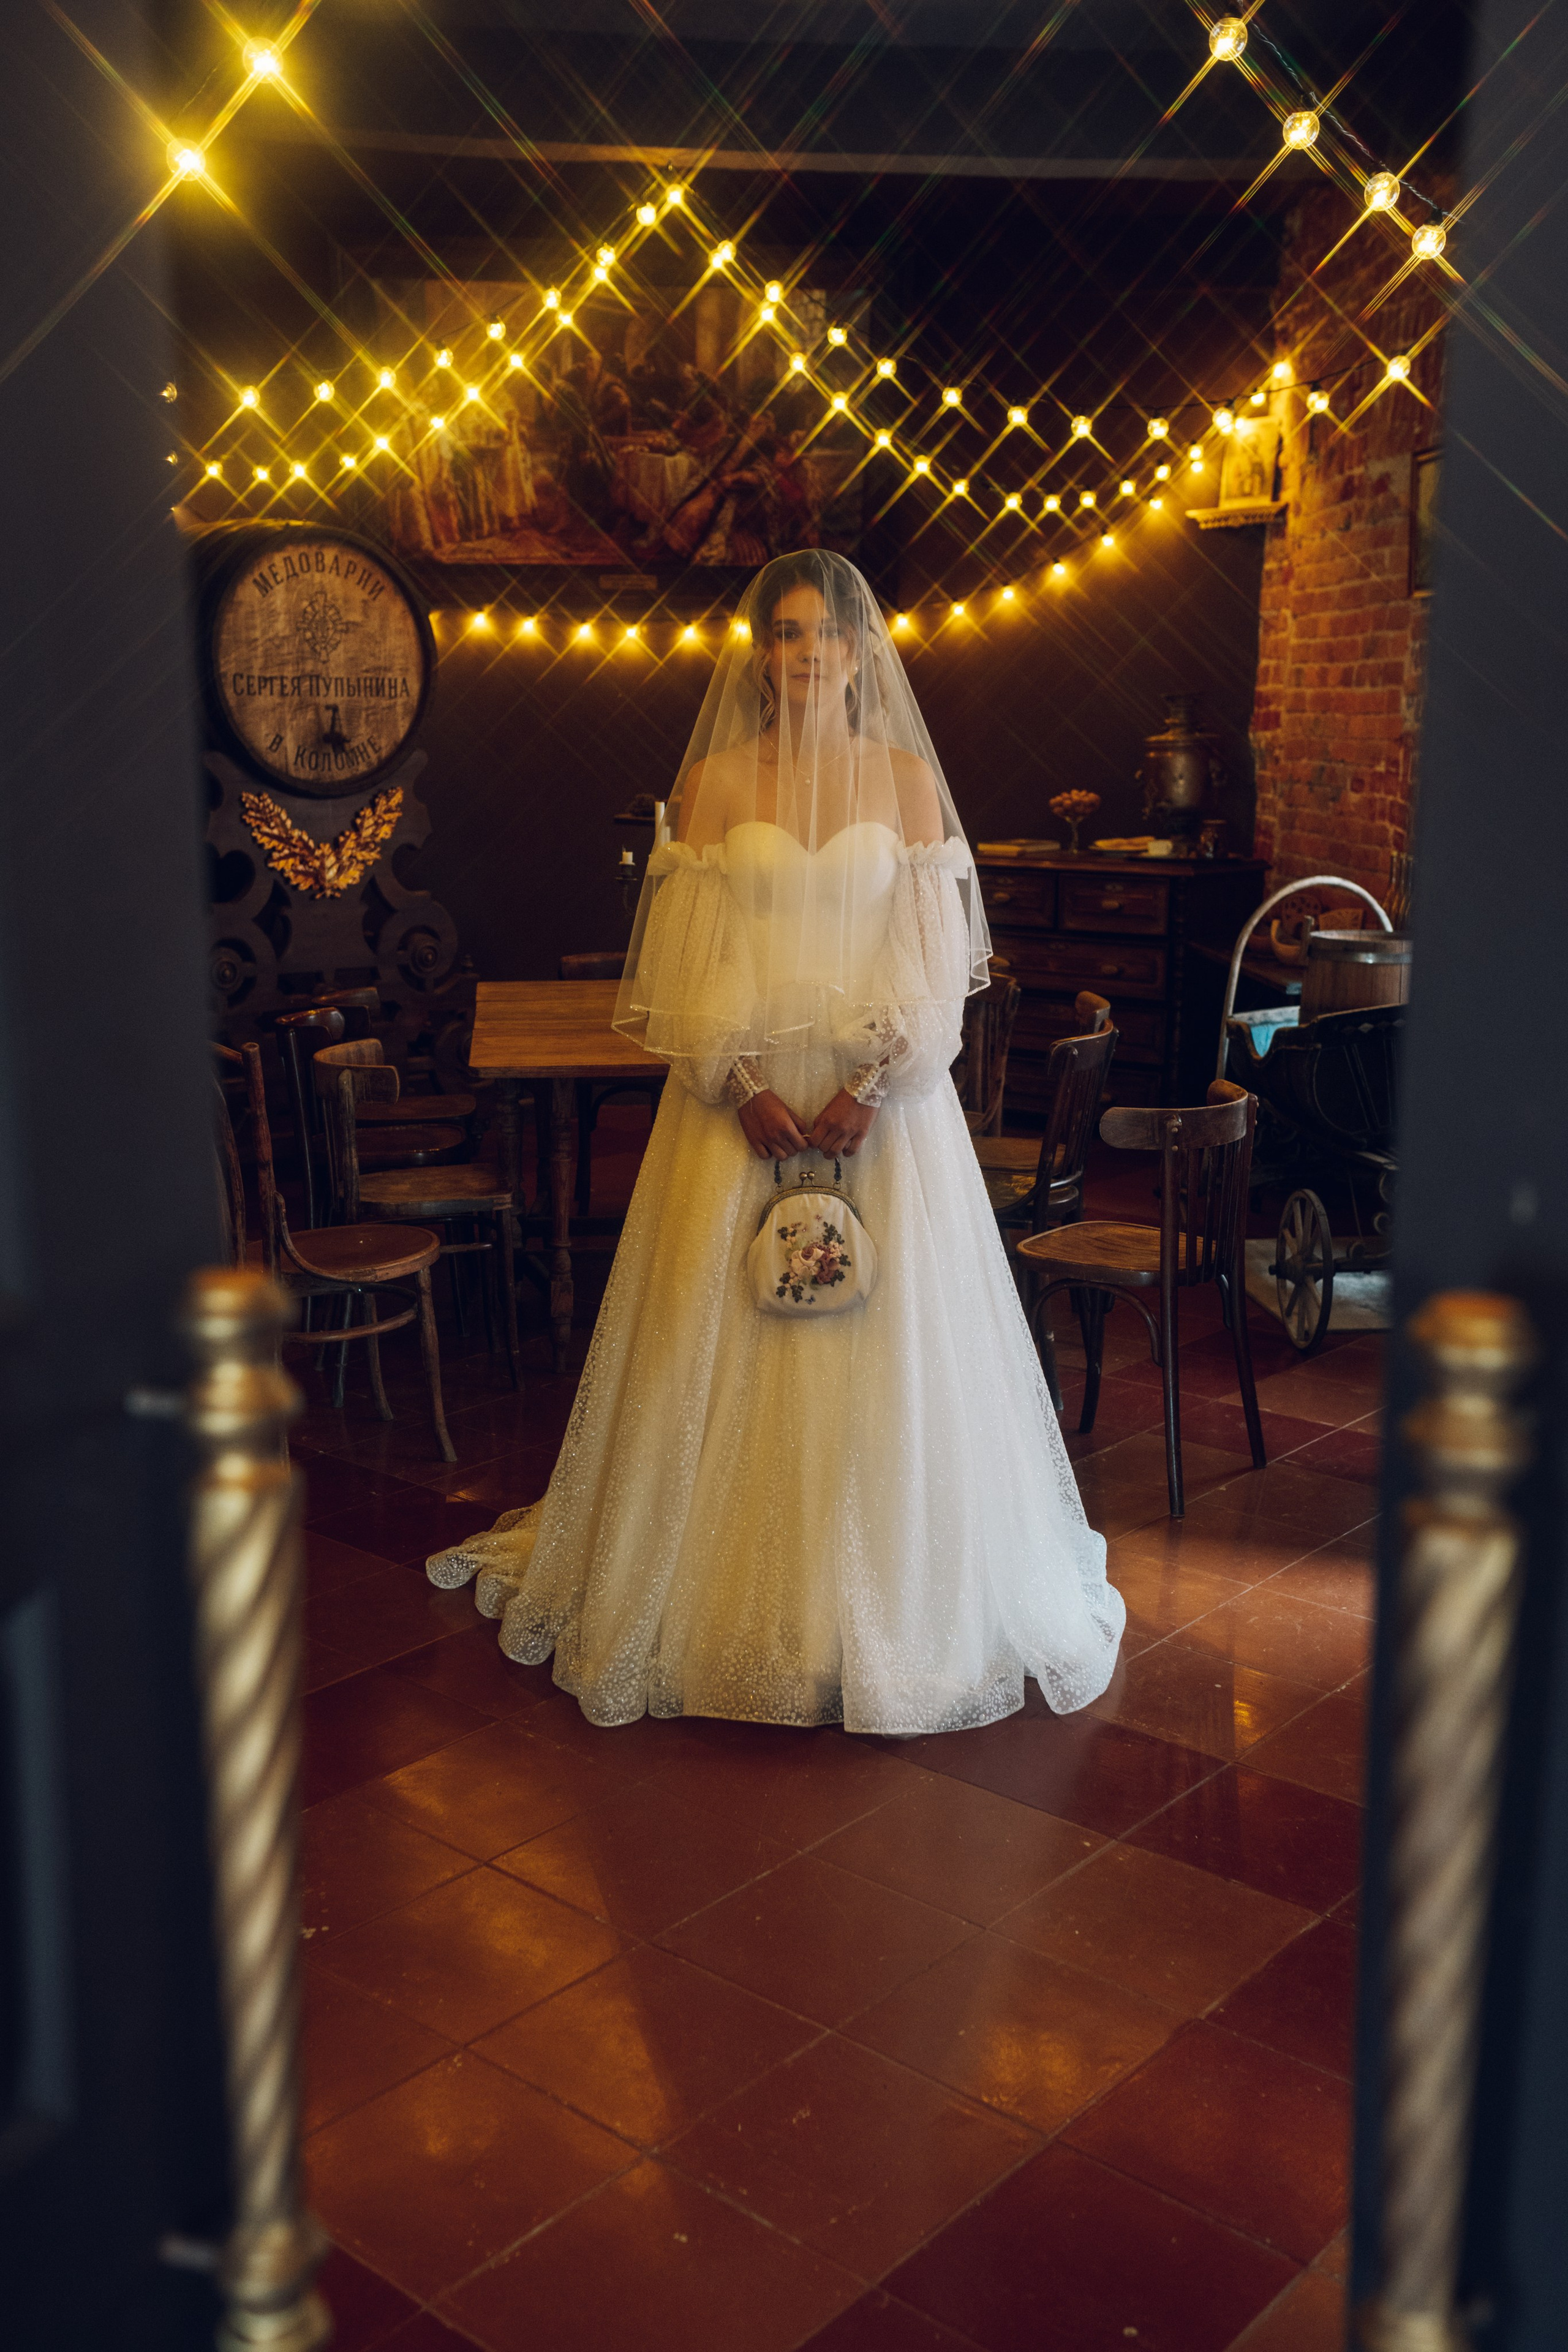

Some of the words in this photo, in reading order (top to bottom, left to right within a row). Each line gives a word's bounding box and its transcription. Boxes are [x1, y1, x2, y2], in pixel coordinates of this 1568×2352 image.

[252, 551, 385, 601] МЕДОВАРНИ
[232, 672, 301, 697] СЕРГЕЯ
[294, 736, 382, 772] КОЛОМНЕ
